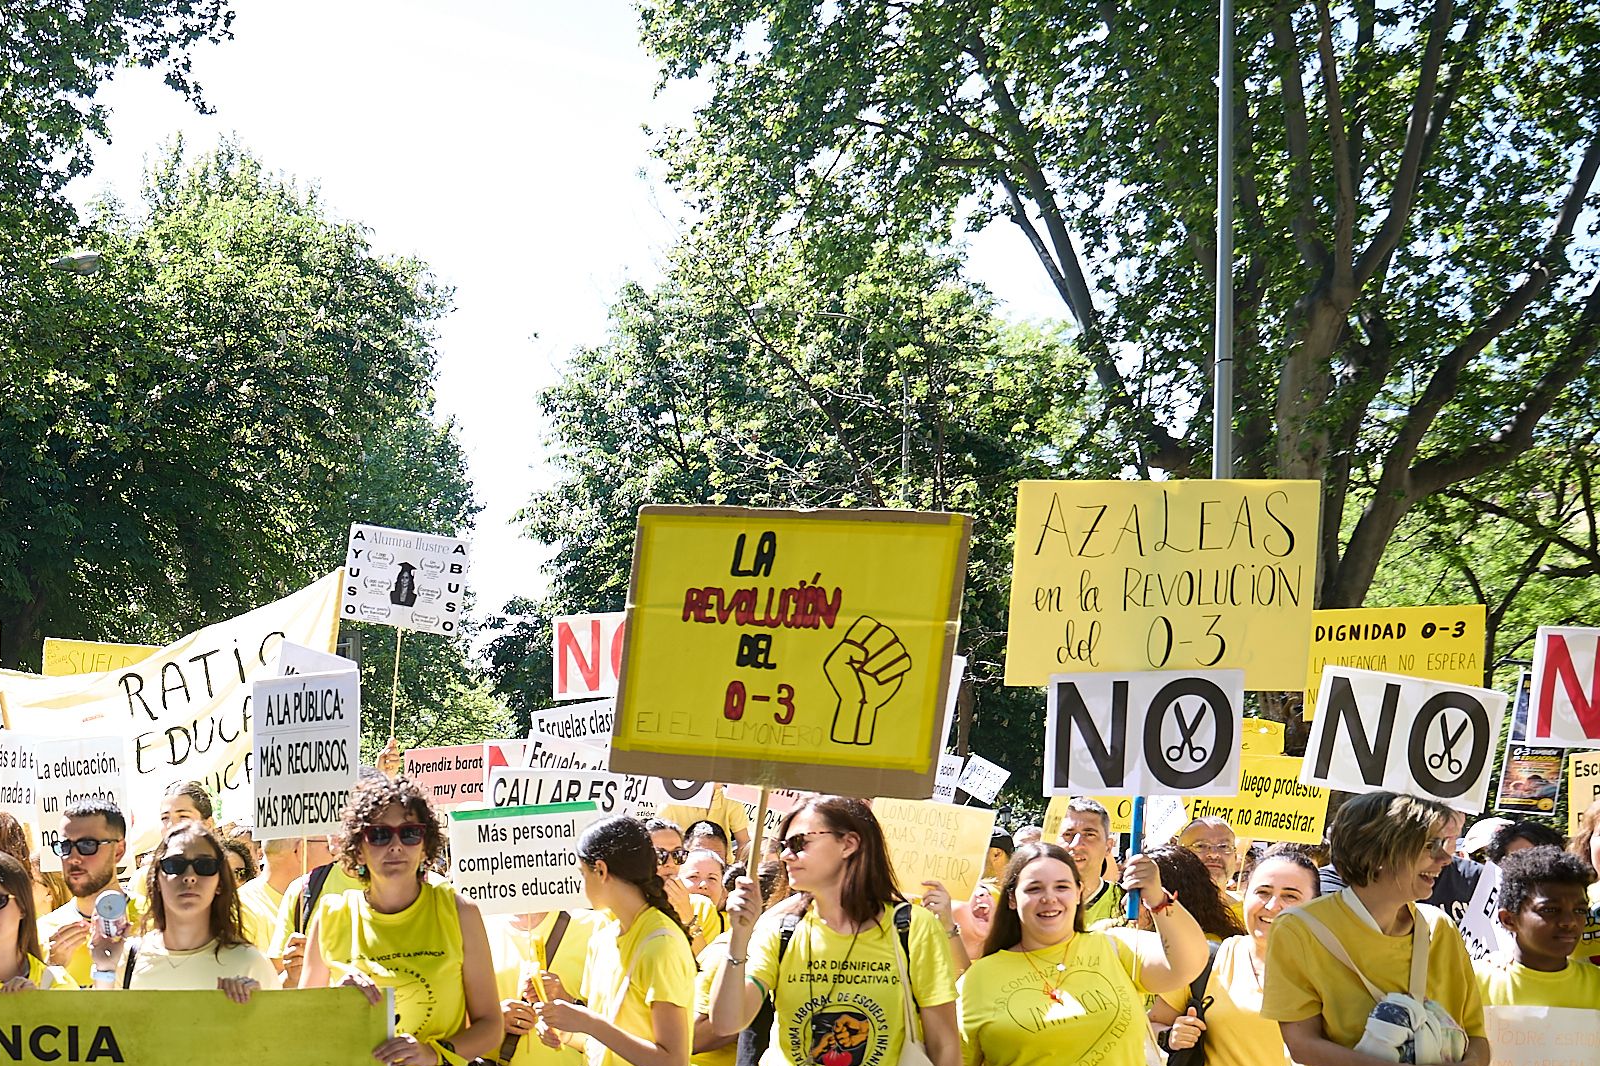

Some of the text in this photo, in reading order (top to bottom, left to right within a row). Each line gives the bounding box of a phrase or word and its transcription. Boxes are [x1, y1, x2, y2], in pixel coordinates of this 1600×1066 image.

[1034, 489, 1295, 559] AZALEAS
[369, 531, 450, 555] Alumna Ilustre
[730, 530, 778, 578] LA
[681, 572, 842, 631] REVOLUCIÓN
[1031, 561, 1303, 613] en la REVOLUCIÓN
[1056, 614, 1227, 669] del 0-3
[1315, 620, 1467, 643] DIGNIDAD 0-3
[557, 620, 625, 694] N
[735, 633, 778, 671] DEL
[1335, 653, 1388, 672] INFANCIA
[1399, 653, 1415, 672] NO
[1427, 652, 1478, 672] ESPERA
[265, 683, 344, 727] A LA PÚBLICA:
[723, 680, 796, 726] 0-3
[714, 715, 825, 748] LIMONERO
[1053, 677, 1234, 790] NO
[1313, 675, 1492, 799] NO
[35, 751, 120, 780] La educación,
[260, 736, 282, 778] MÁS
[287, 738, 349, 776] RECURSOS,
[408, 756, 452, 779] Aprendiz
[0, 781, 22, 804] nada
[433, 783, 458, 798] muy
[1240, 769, 1271, 799] luego
[43, 795, 59, 813] un
[257, 788, 279, 829] MÁS
[881, 802, 960, 831] CONDICIONES
[477, 819, 576, 846] Más personal
[1236, 808, 1253, 826] no
[1253, 807, 1316, 834] amaestrar.
[924, 828, 957, 849] PARA
[458, 847, 577, 876] complementario
[922, 854, 971, 888] MEJOR
[376, 953, 391, 962] VOZ
[413, 950, 446, 958] INFANCIA
[806, 959, 892, 972] POR DIGNIFICAR
[799, 972, 829, 984] ETAPA
[831, 973, 890, 986] EDUCATIVA
[1000, 955, 1101, 995] COMIENZ LA
[793, 994, 833, 1027] LABORAL
[837, 991, 851, 1002] DE
